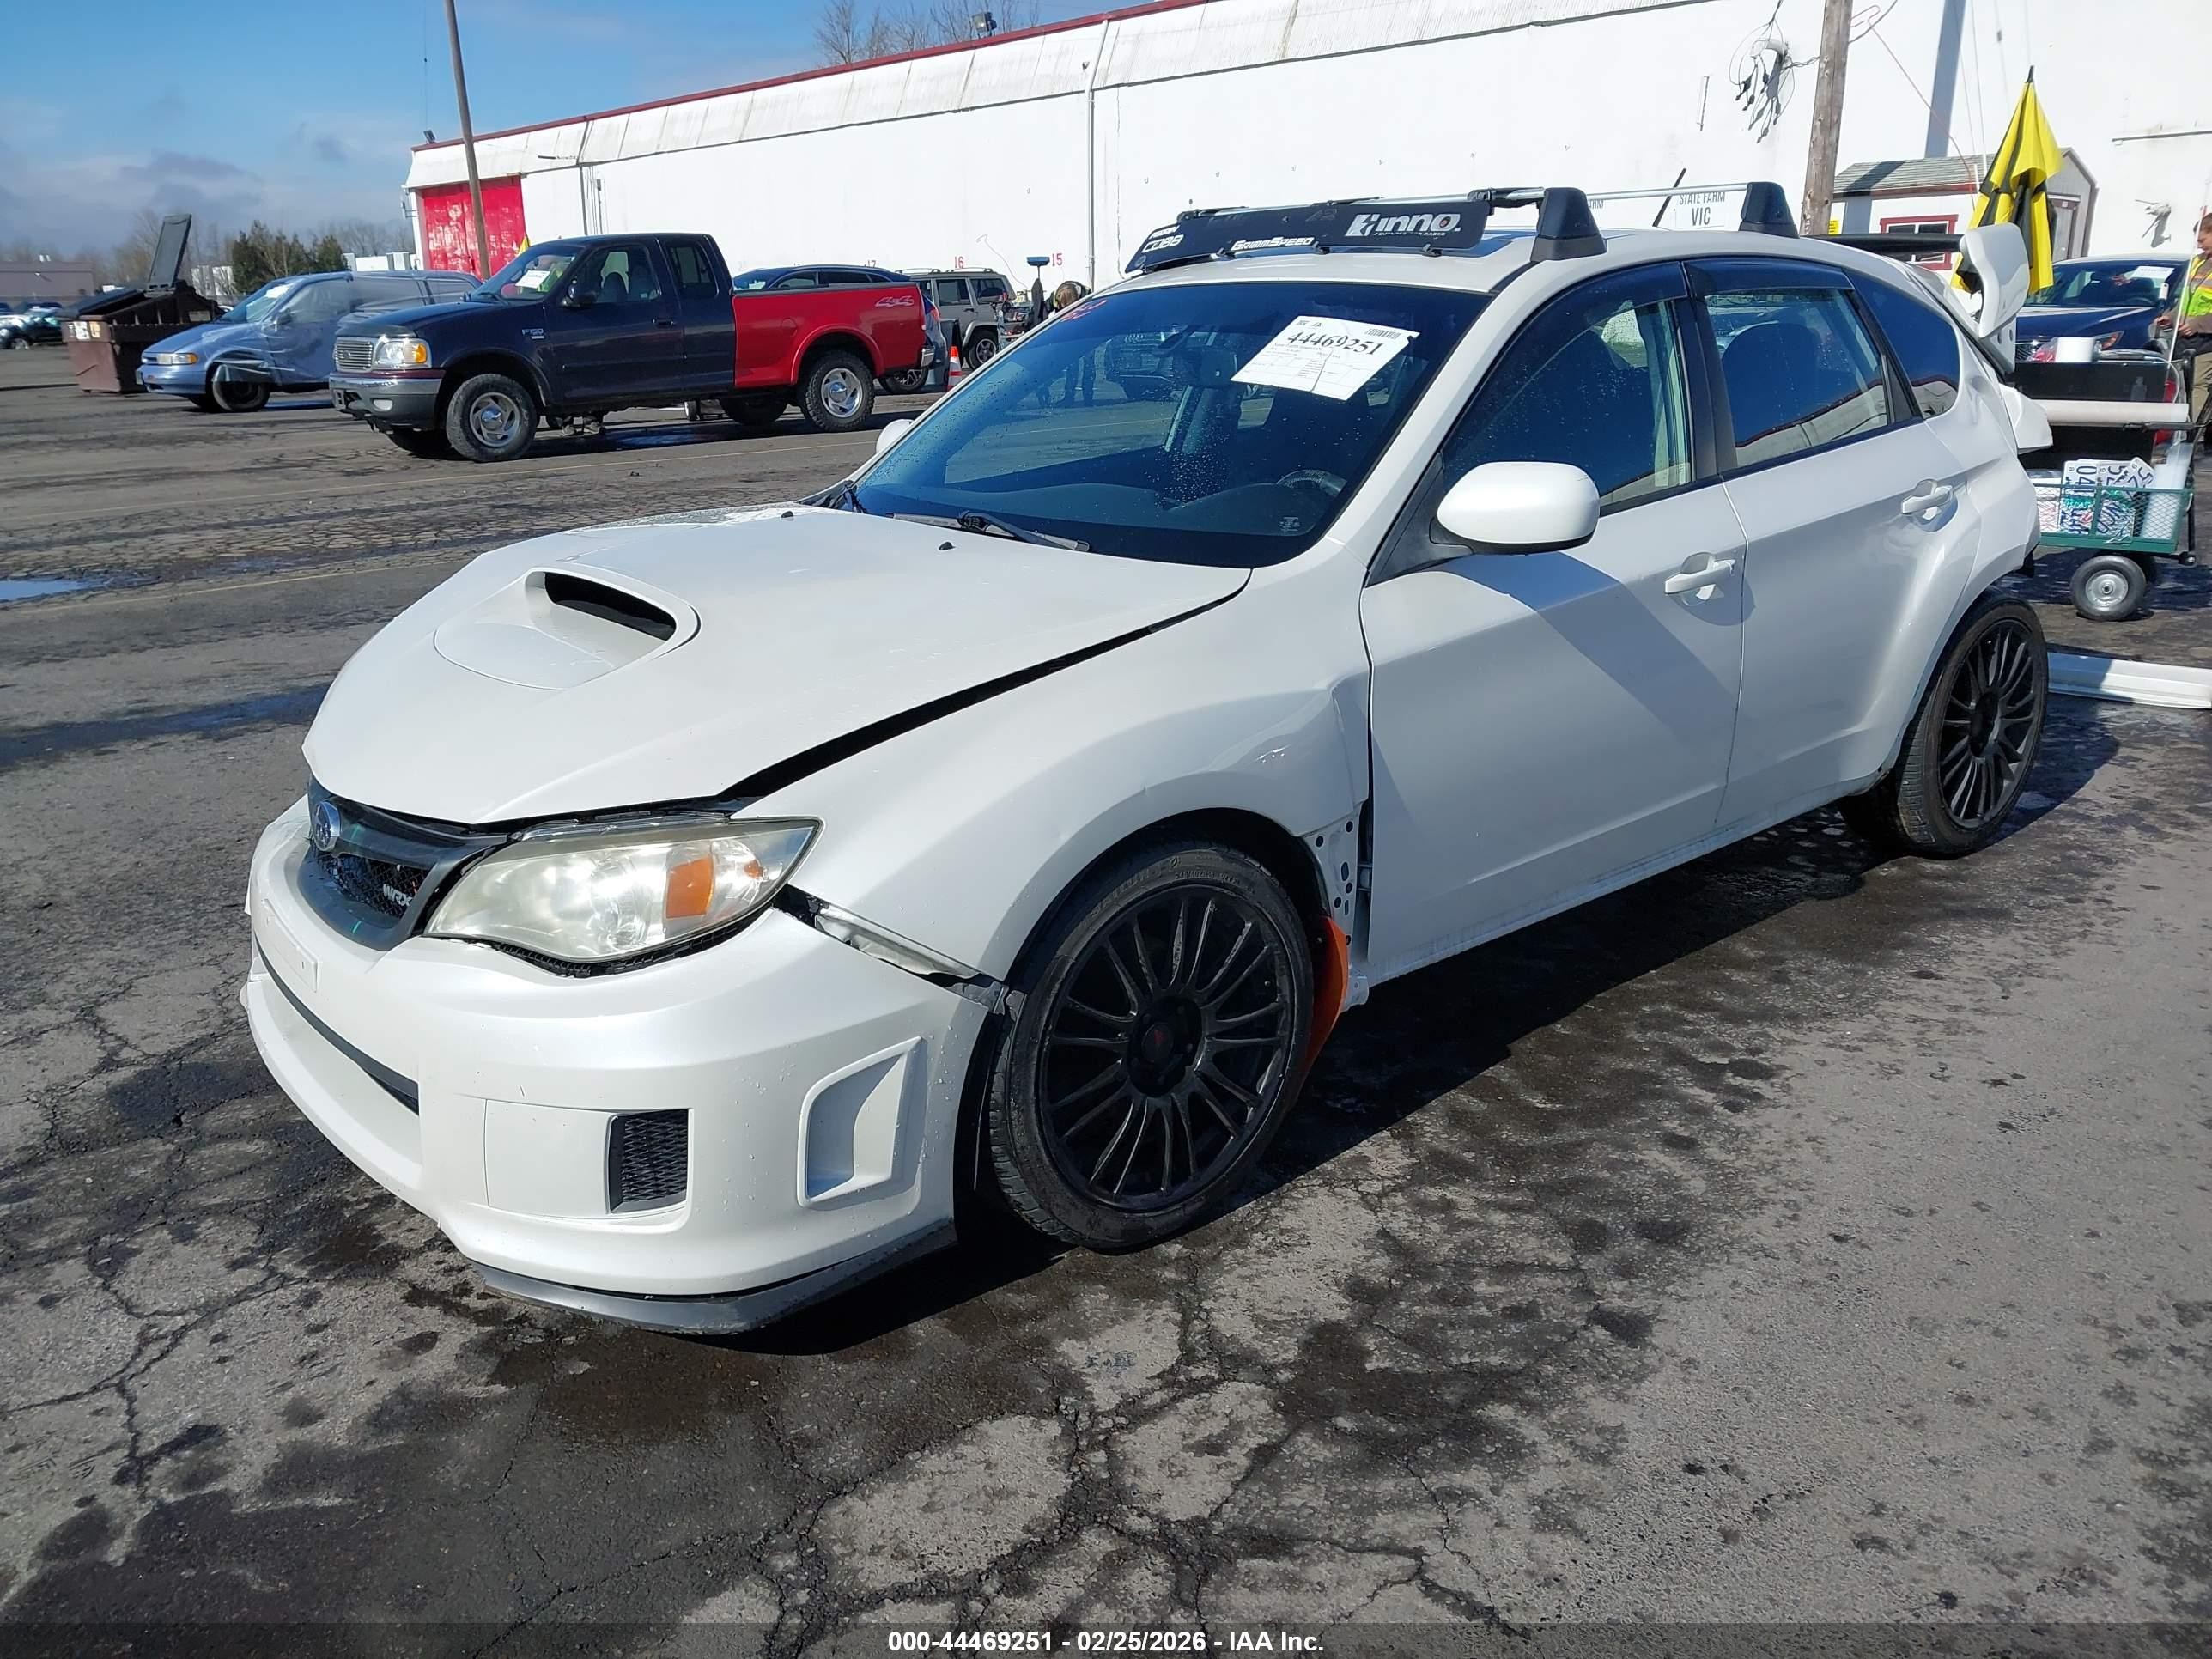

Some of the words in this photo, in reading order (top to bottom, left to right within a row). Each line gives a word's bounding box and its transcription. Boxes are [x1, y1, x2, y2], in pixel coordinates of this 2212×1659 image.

[1679, 192, 1701, 205] STATE
[1703, 191, 1725, 204] FARM
[1692, 206, 1711, 226] VIC
[1141, 234, 1184, 253] COBB
[954, 256, 964, 269] 16
[1051, 252, 1063, 267] 15
[1287, 331, 1384, 355] 44469251
[383, 884, 413, 906] WRX
